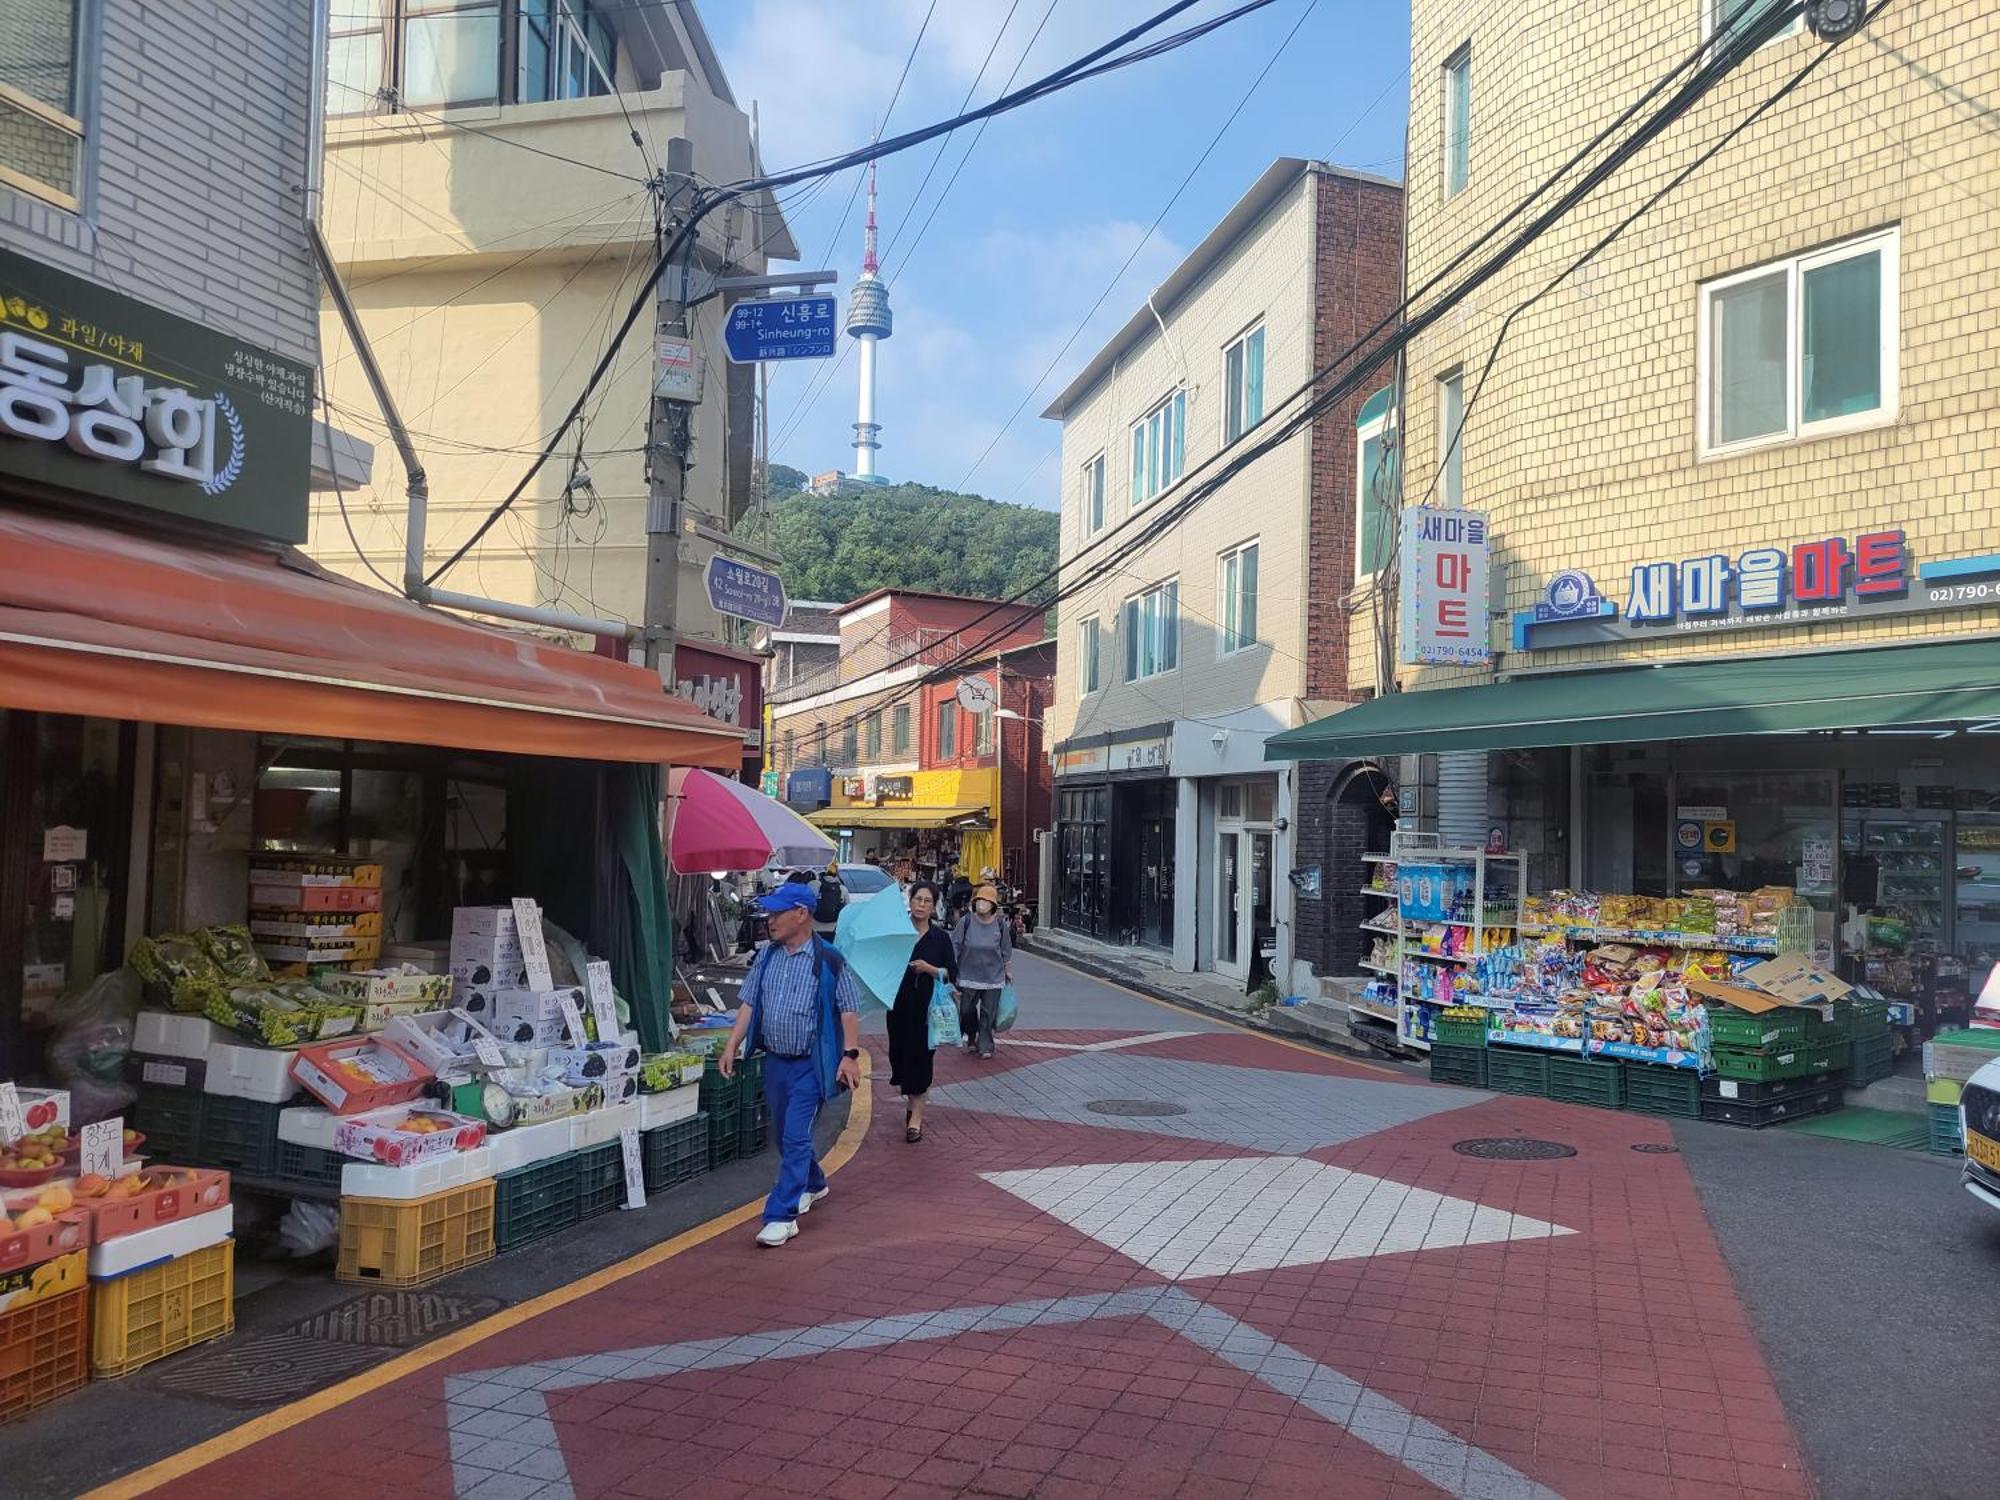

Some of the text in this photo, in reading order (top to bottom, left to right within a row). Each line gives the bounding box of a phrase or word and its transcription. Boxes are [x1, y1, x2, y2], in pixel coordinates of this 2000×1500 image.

[781, 303, 830, 324] 신흥로
[757, 327, 831, 341] Sinheung-ro
[1422, 516, 1484, 545] 새마을
[86, 1121, 121, 1148] 황도
